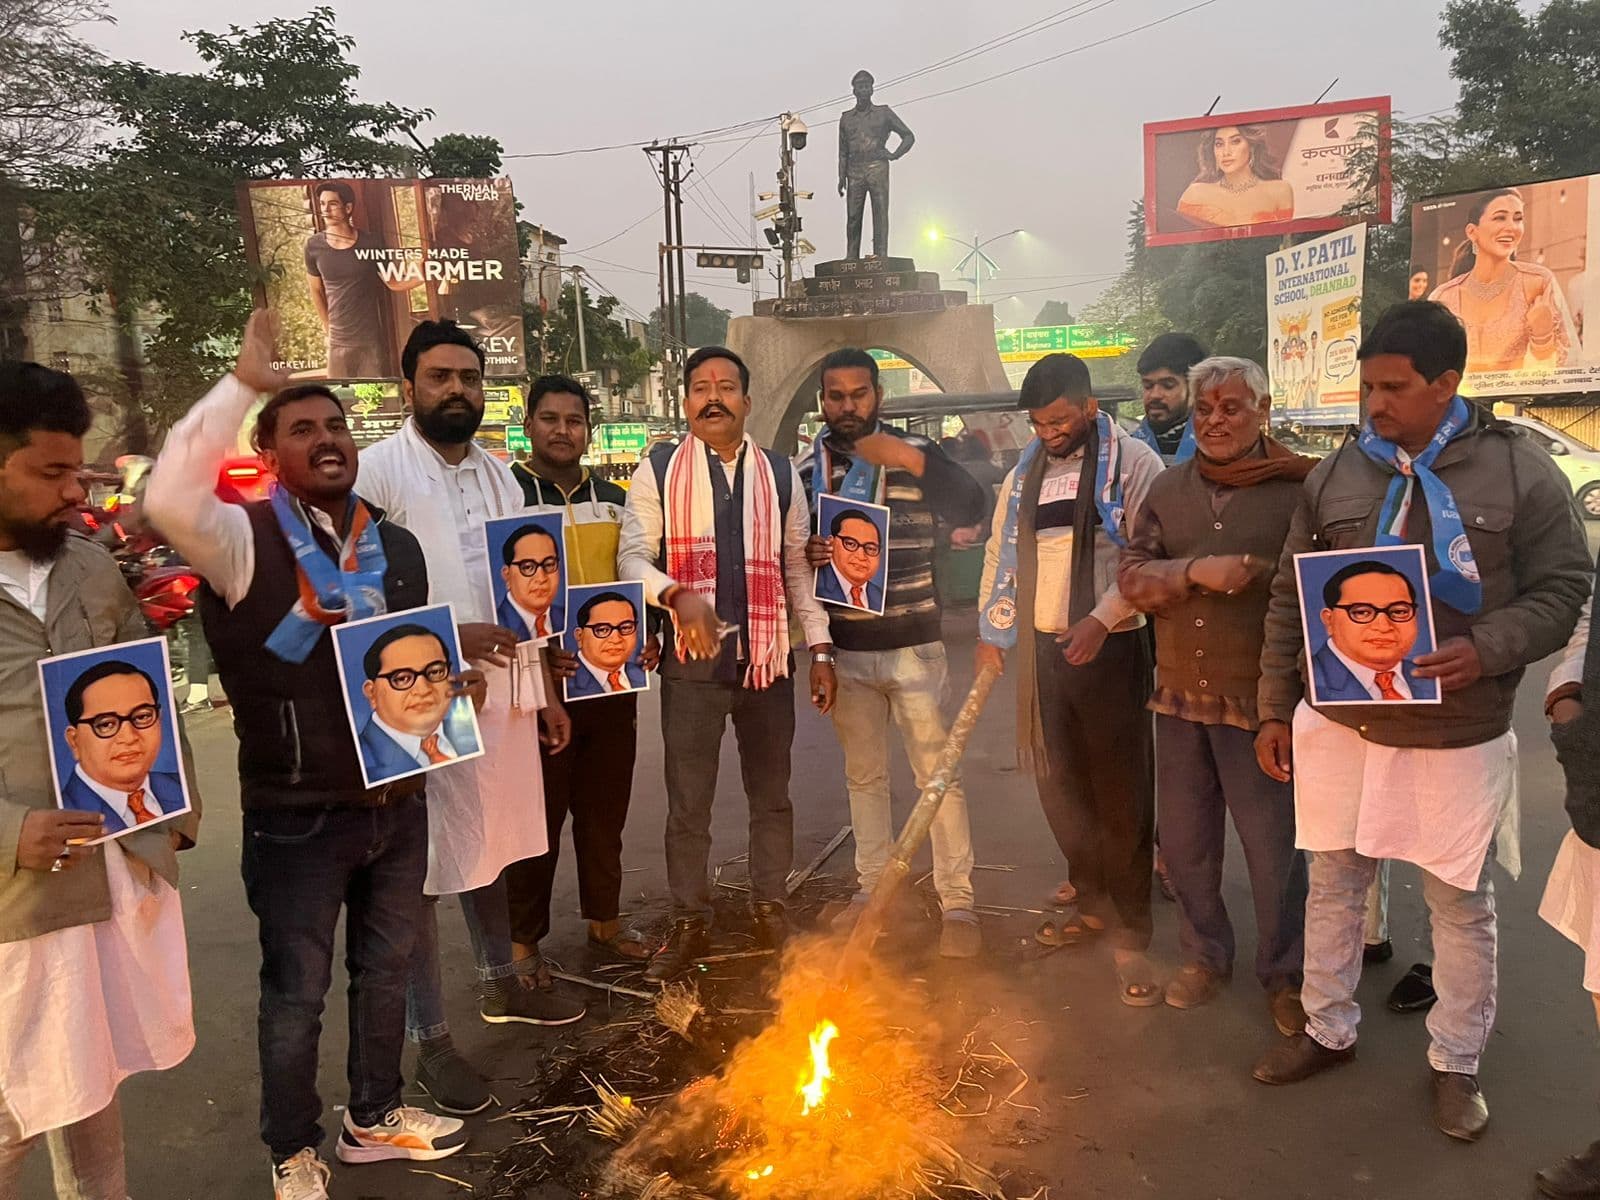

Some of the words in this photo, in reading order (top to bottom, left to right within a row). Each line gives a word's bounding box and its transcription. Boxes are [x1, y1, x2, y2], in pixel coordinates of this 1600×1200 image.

[438, 184, 494, 194] THERMAL
[460, 191, 500, 201] WEAR
[354, 248, 423, 260] WINTERS
[427, 248, 470, 259] MADE
[1275, 256, 1288, 277] D.
[1291, 250, 1304, 271] Y.
[1308, 234, 1357, 267] PATIL
[376, 260, 504, 282] WARMER
[1278, 262, 1350, 291] INTERNATIONAL
[1310, 275, 1357, 297] DHANBAD
